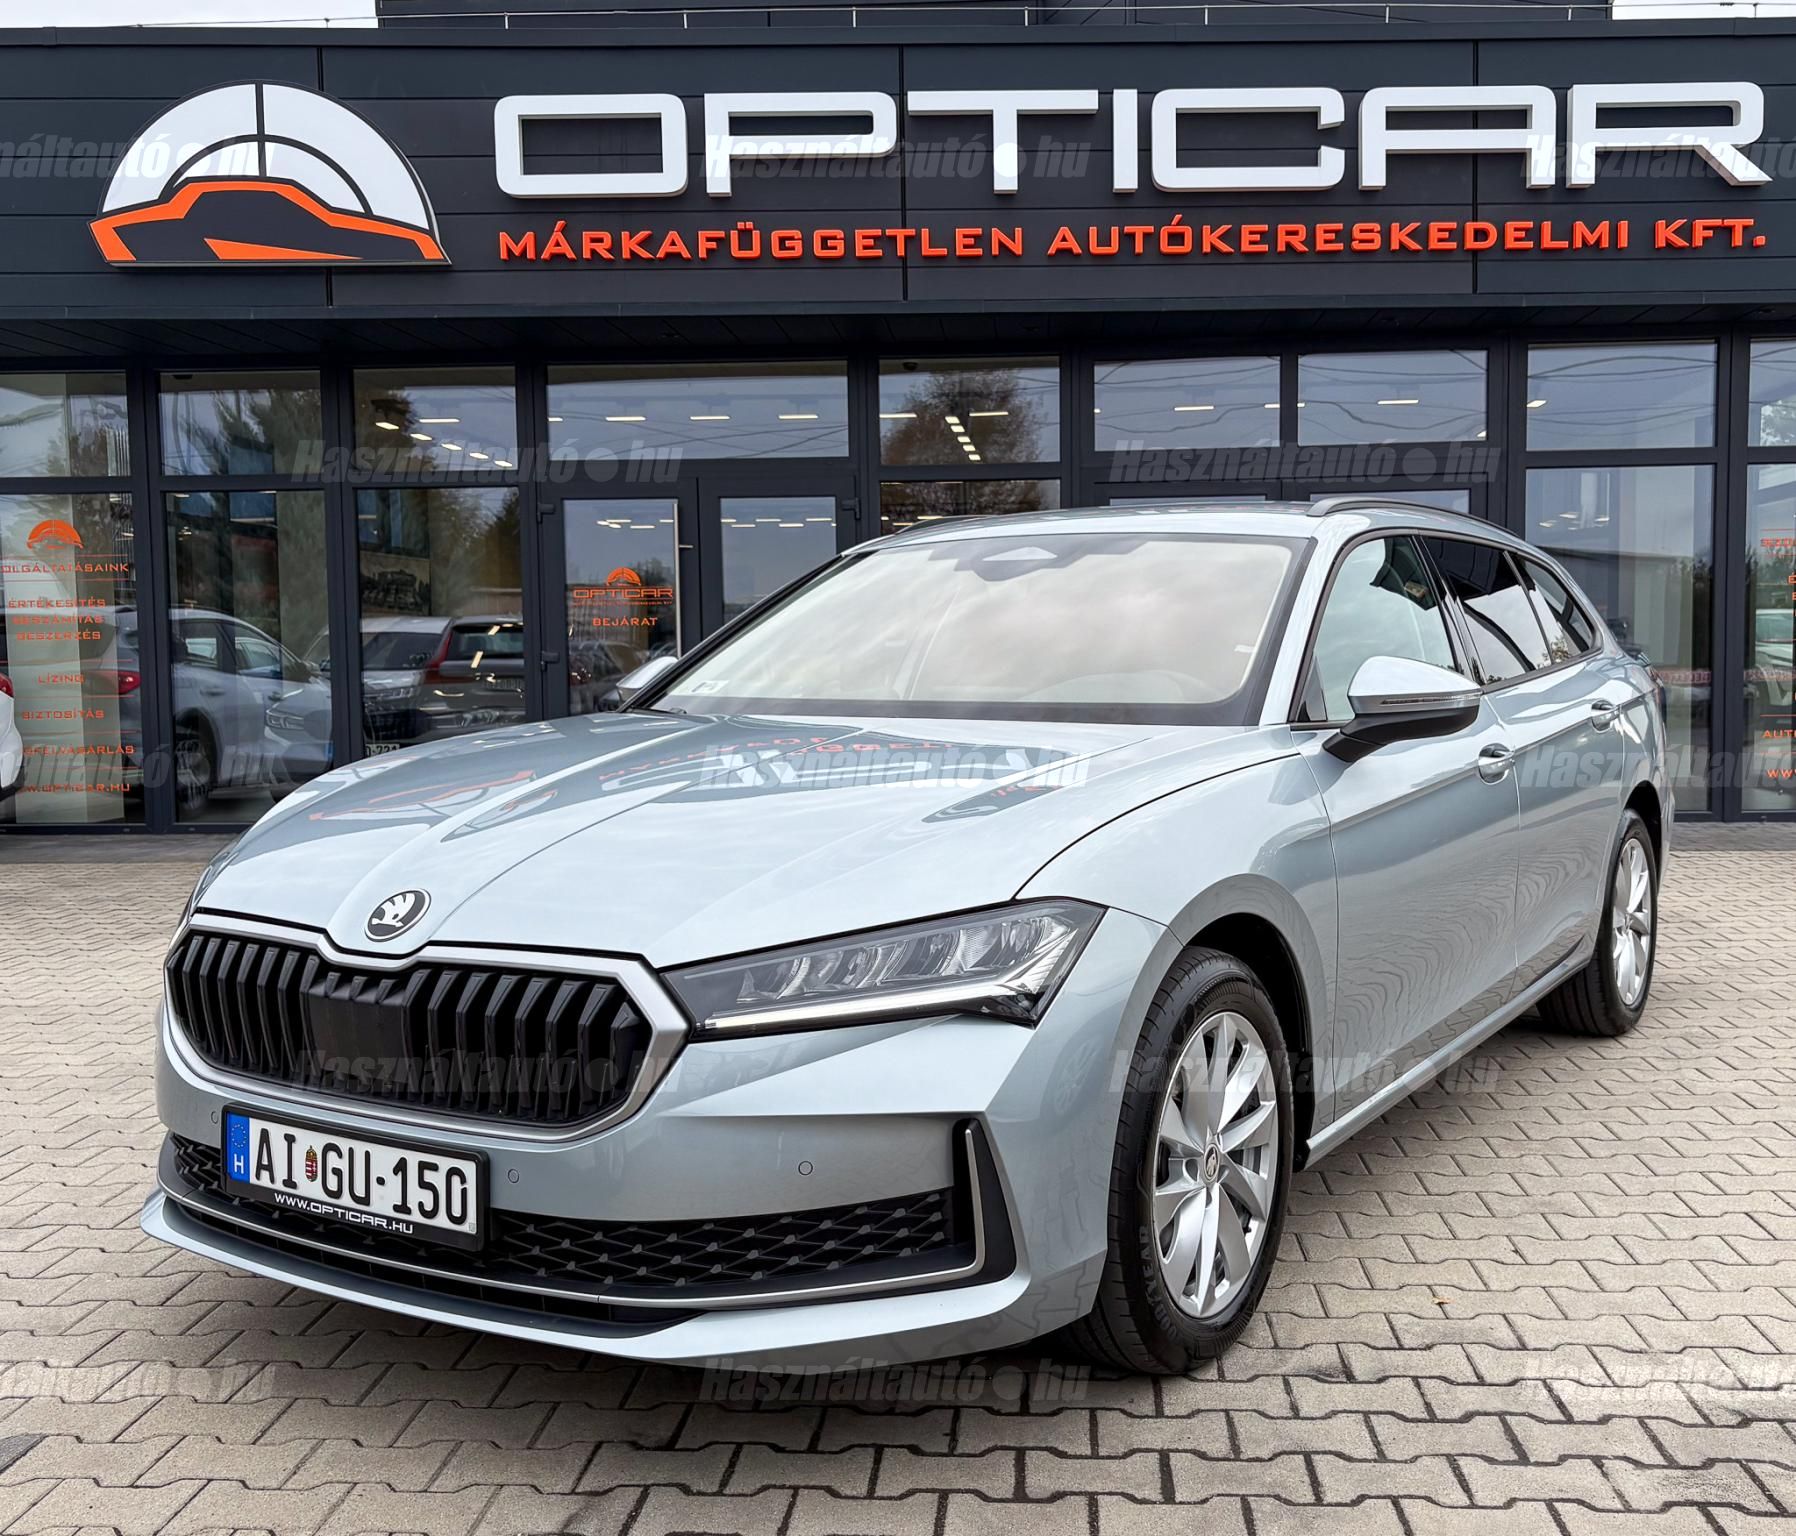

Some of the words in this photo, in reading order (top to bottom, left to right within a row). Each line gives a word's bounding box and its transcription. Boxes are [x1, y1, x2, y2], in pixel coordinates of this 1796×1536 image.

[494, 81, 1773, 199] OPTICAR
[498, 219, 1023, 262] MÁRKAFÜGGETLEN
[1048, 214, 1630, 256] AUTÓKERESKEDELMI
[1655, 217, 1767, 249] KFT.
[573, 588, 673, 599] OPTICAR
[593, 615, 658, 626] BEJÁRAT
[1763, 728, 1796, 738] AUT
[1767, 769, 1796, 779] WW
[233, 1153, 245, 1175] H
[274, 1193, 414, 1234] WWW.OPTICAR.HU
